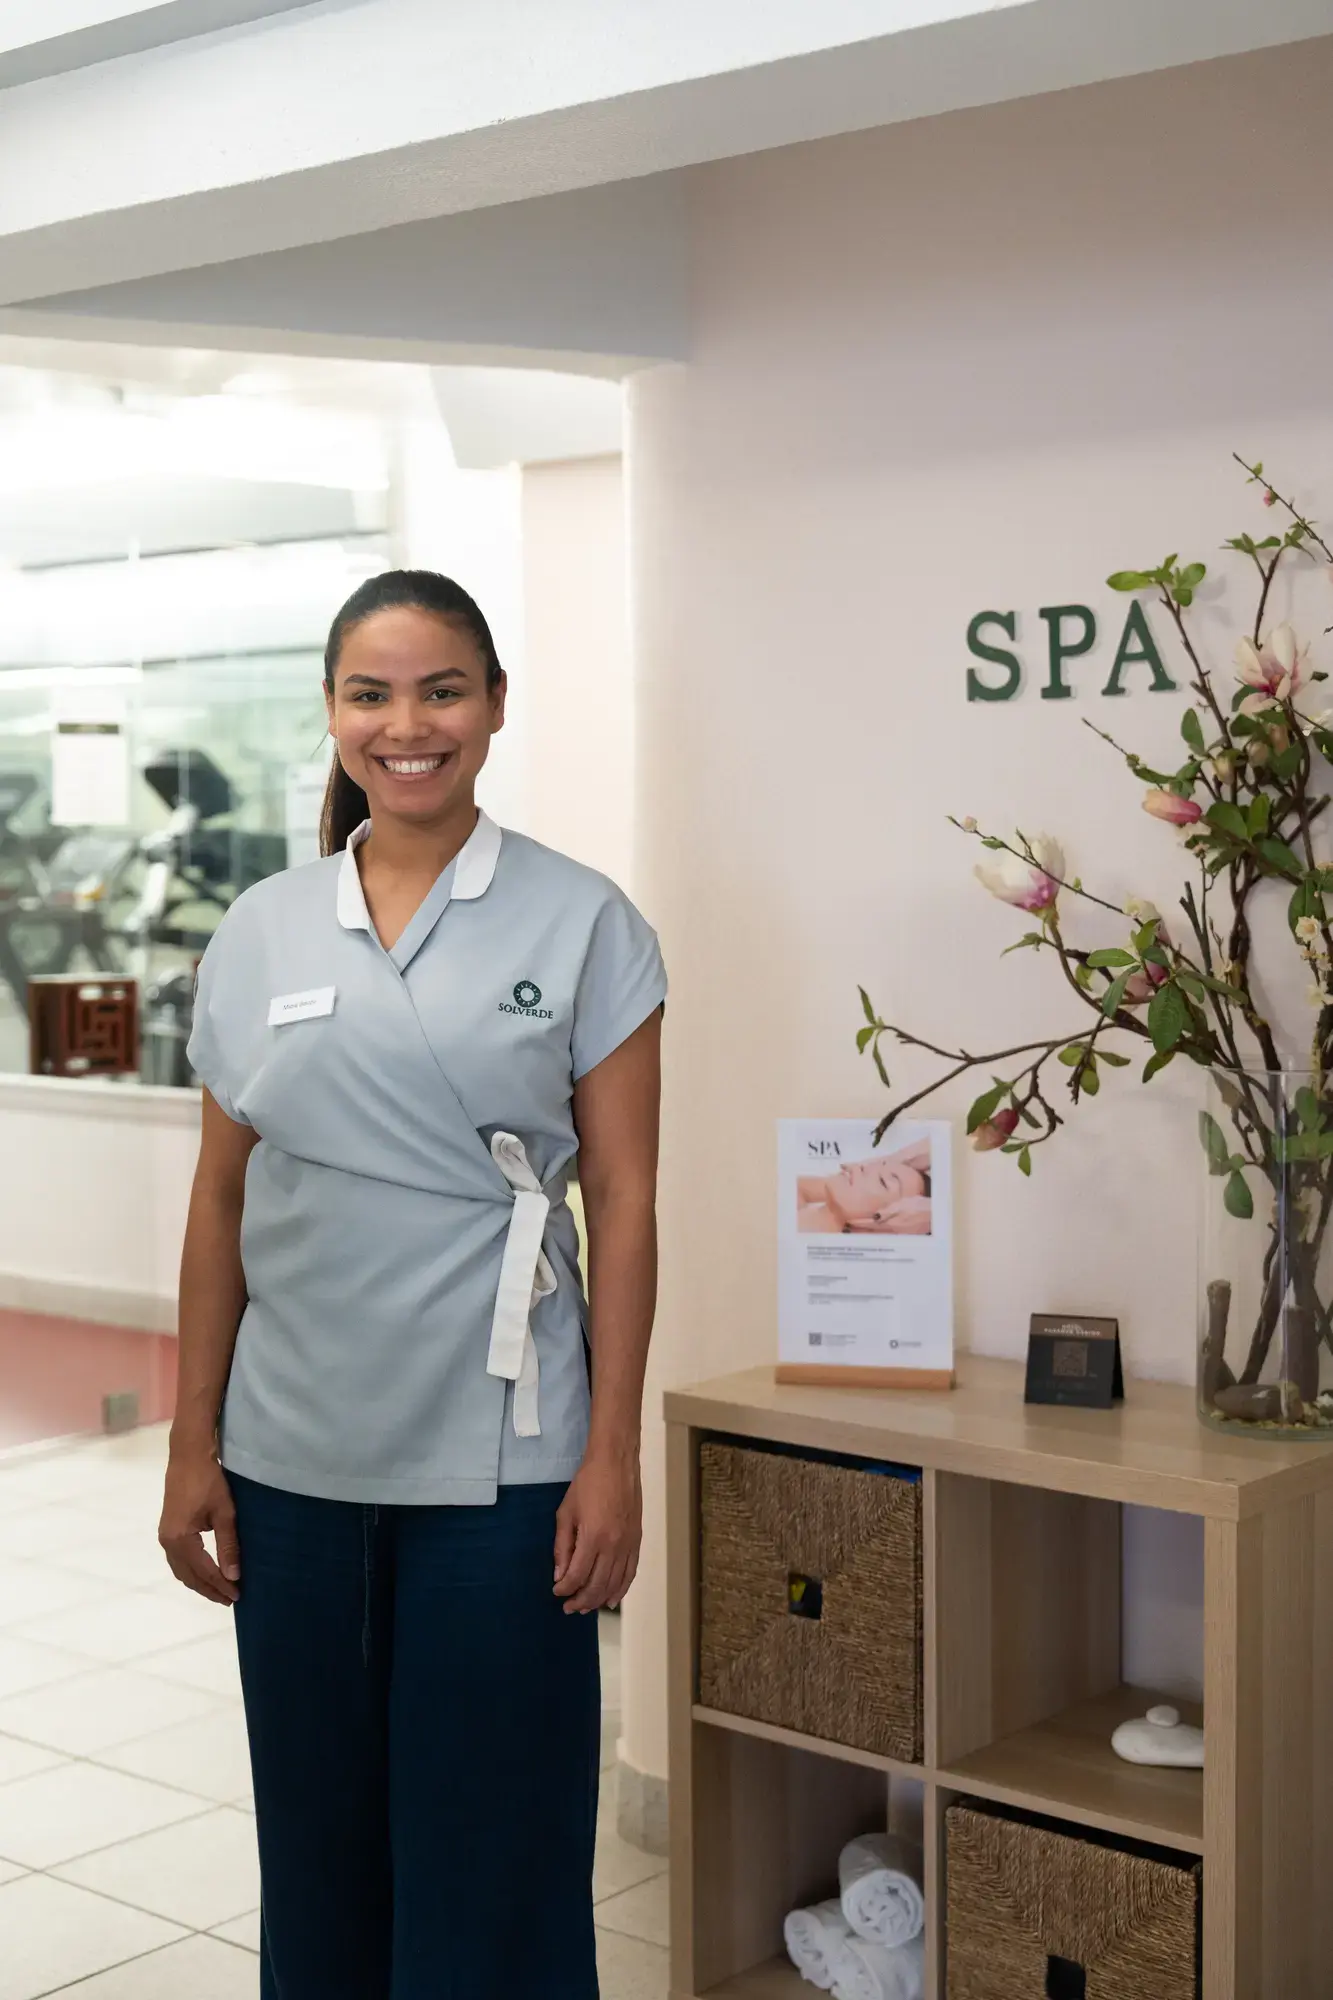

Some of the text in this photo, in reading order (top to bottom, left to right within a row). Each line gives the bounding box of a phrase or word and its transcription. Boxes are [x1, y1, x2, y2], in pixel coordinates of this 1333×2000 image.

[966, 599, 1177, 702] SPA
[498, 1002, 554, 1019] SOLVERDE
[807, 1140, 841, 1156] SPA
